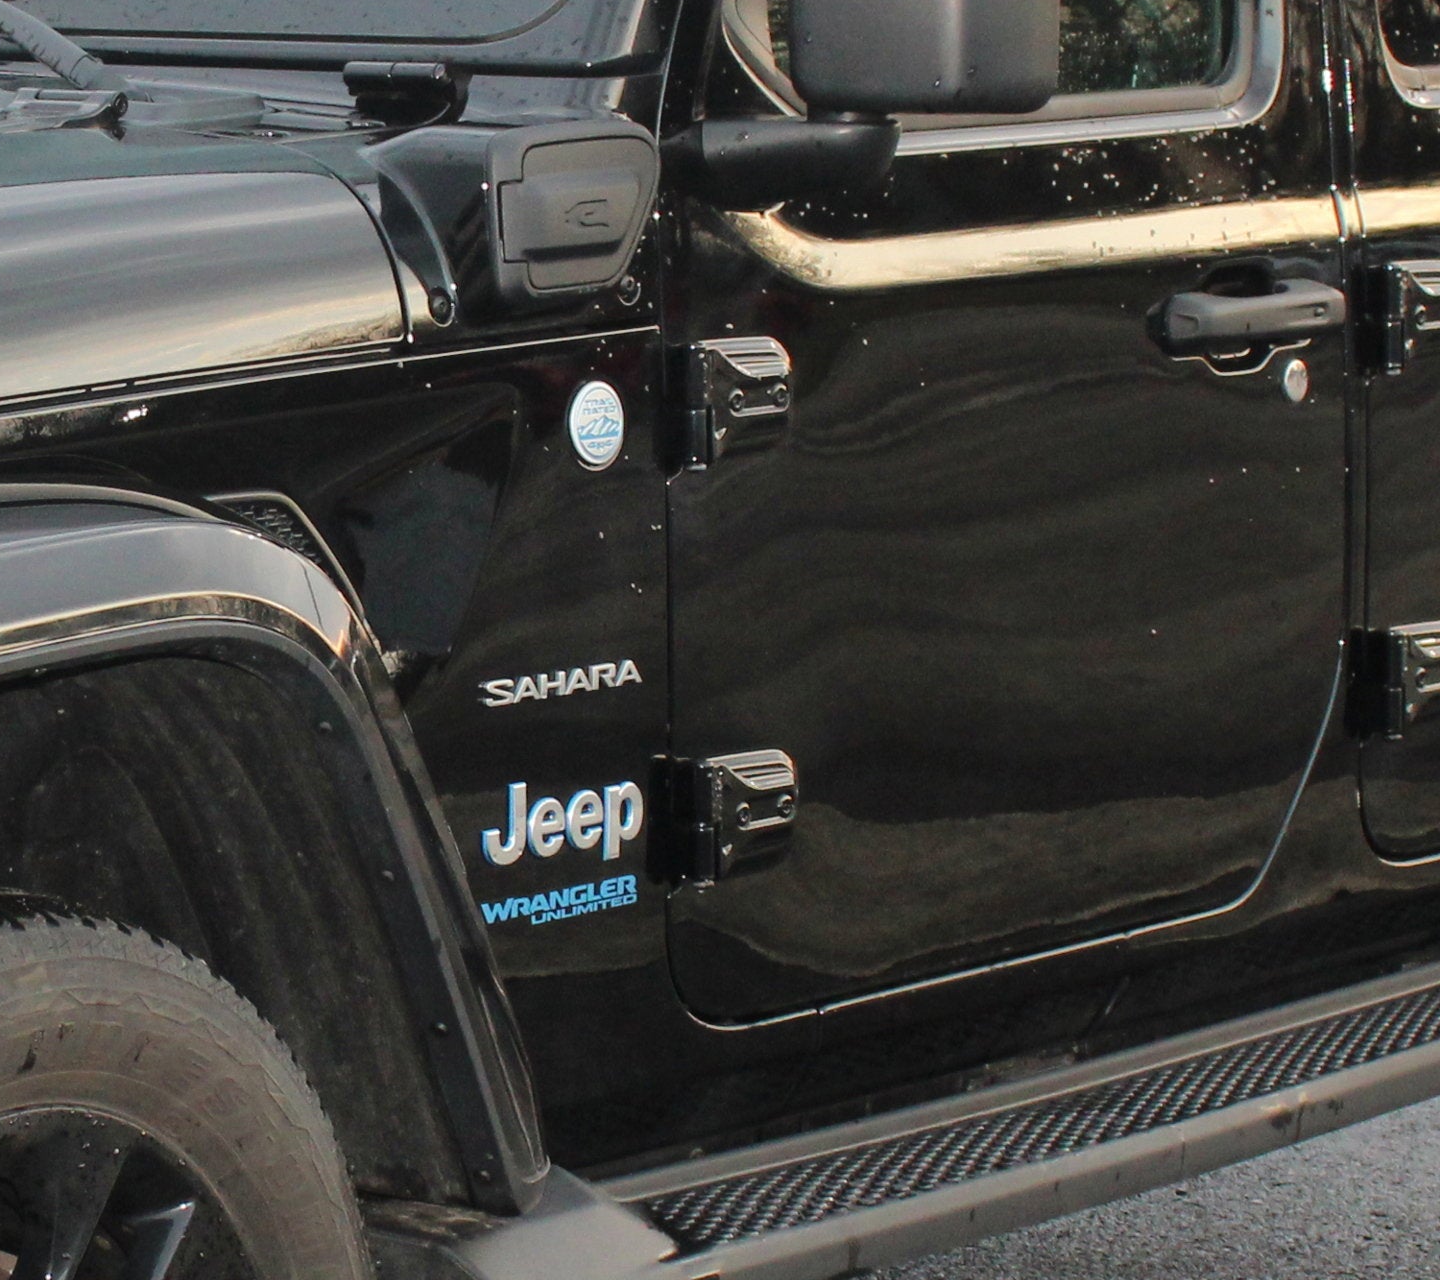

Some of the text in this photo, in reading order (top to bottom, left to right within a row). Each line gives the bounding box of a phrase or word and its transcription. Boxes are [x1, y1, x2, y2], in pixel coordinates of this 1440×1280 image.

[484, 659, 643, 708] SAHARA
[481, 780, 644, 866] Jeep
[481, 874, 638, 925] WRANGLER
[531, 893, 638, 925] UNLIMITED
